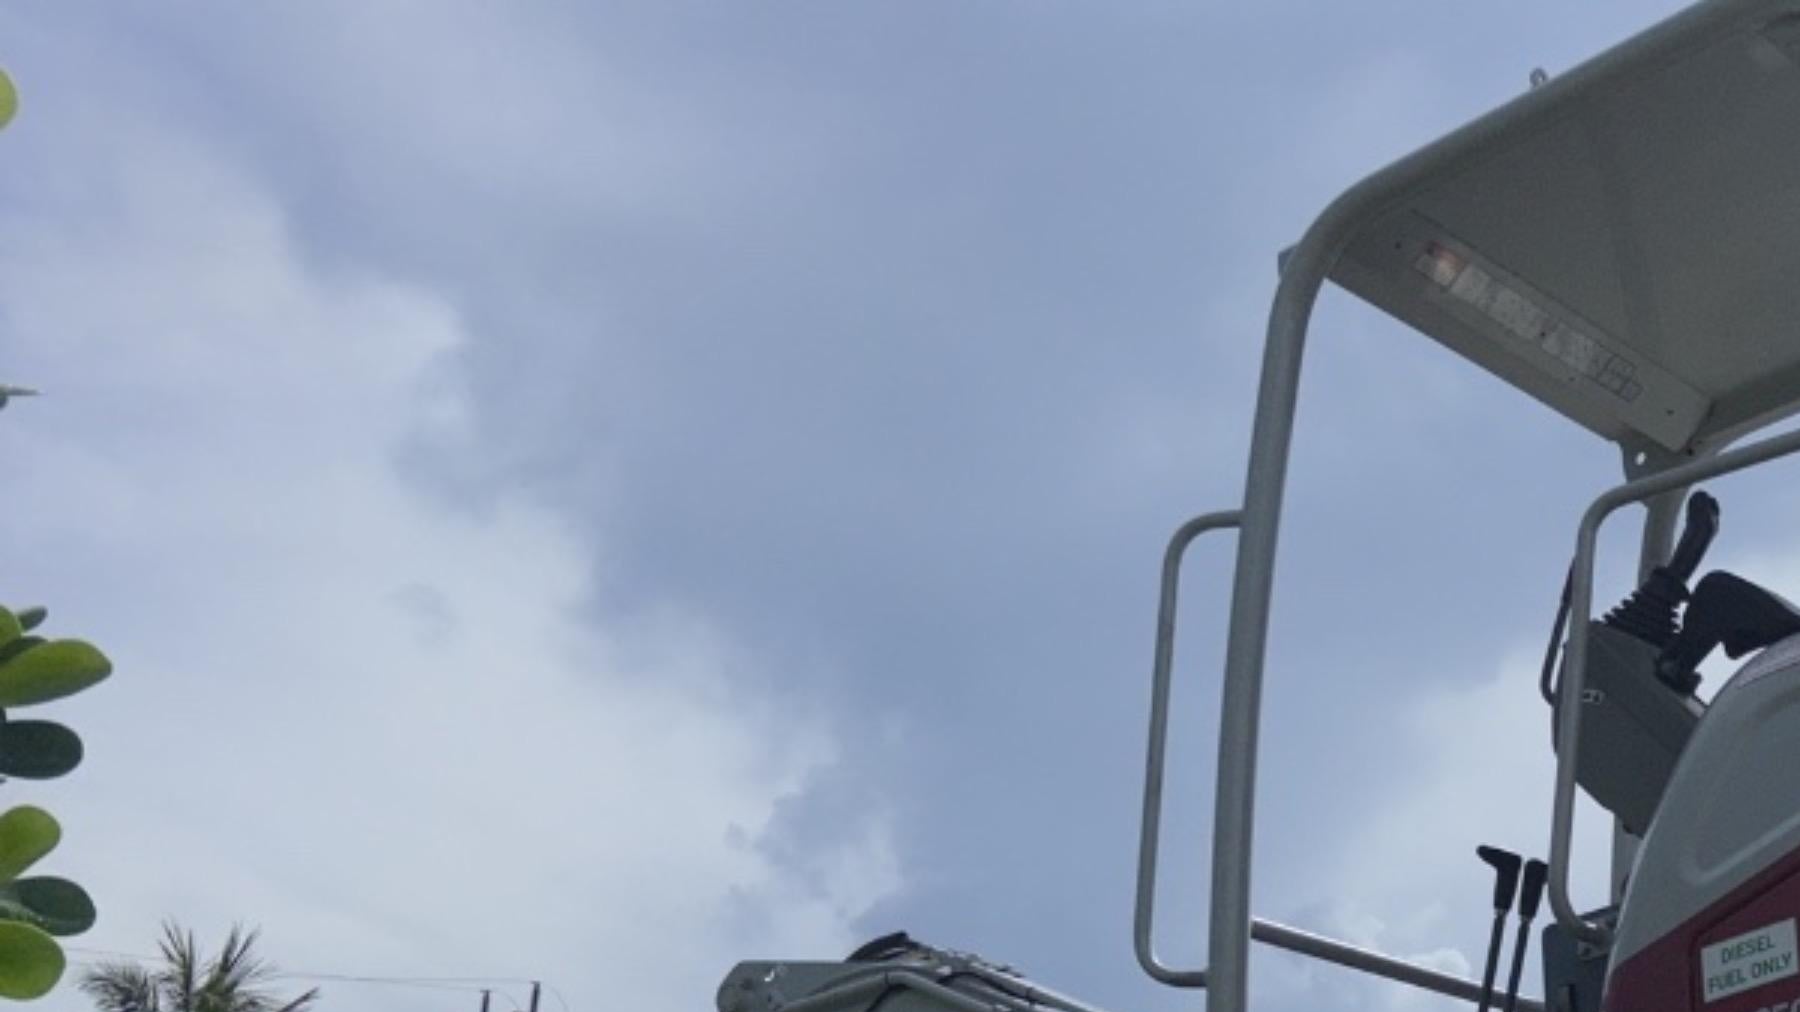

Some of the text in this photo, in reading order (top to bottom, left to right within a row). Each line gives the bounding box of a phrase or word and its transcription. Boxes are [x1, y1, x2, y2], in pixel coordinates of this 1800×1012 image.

[1720, 935, 1775, 965] DIESEL
[1708, 952, 1793, 994] FUEL ONLY
